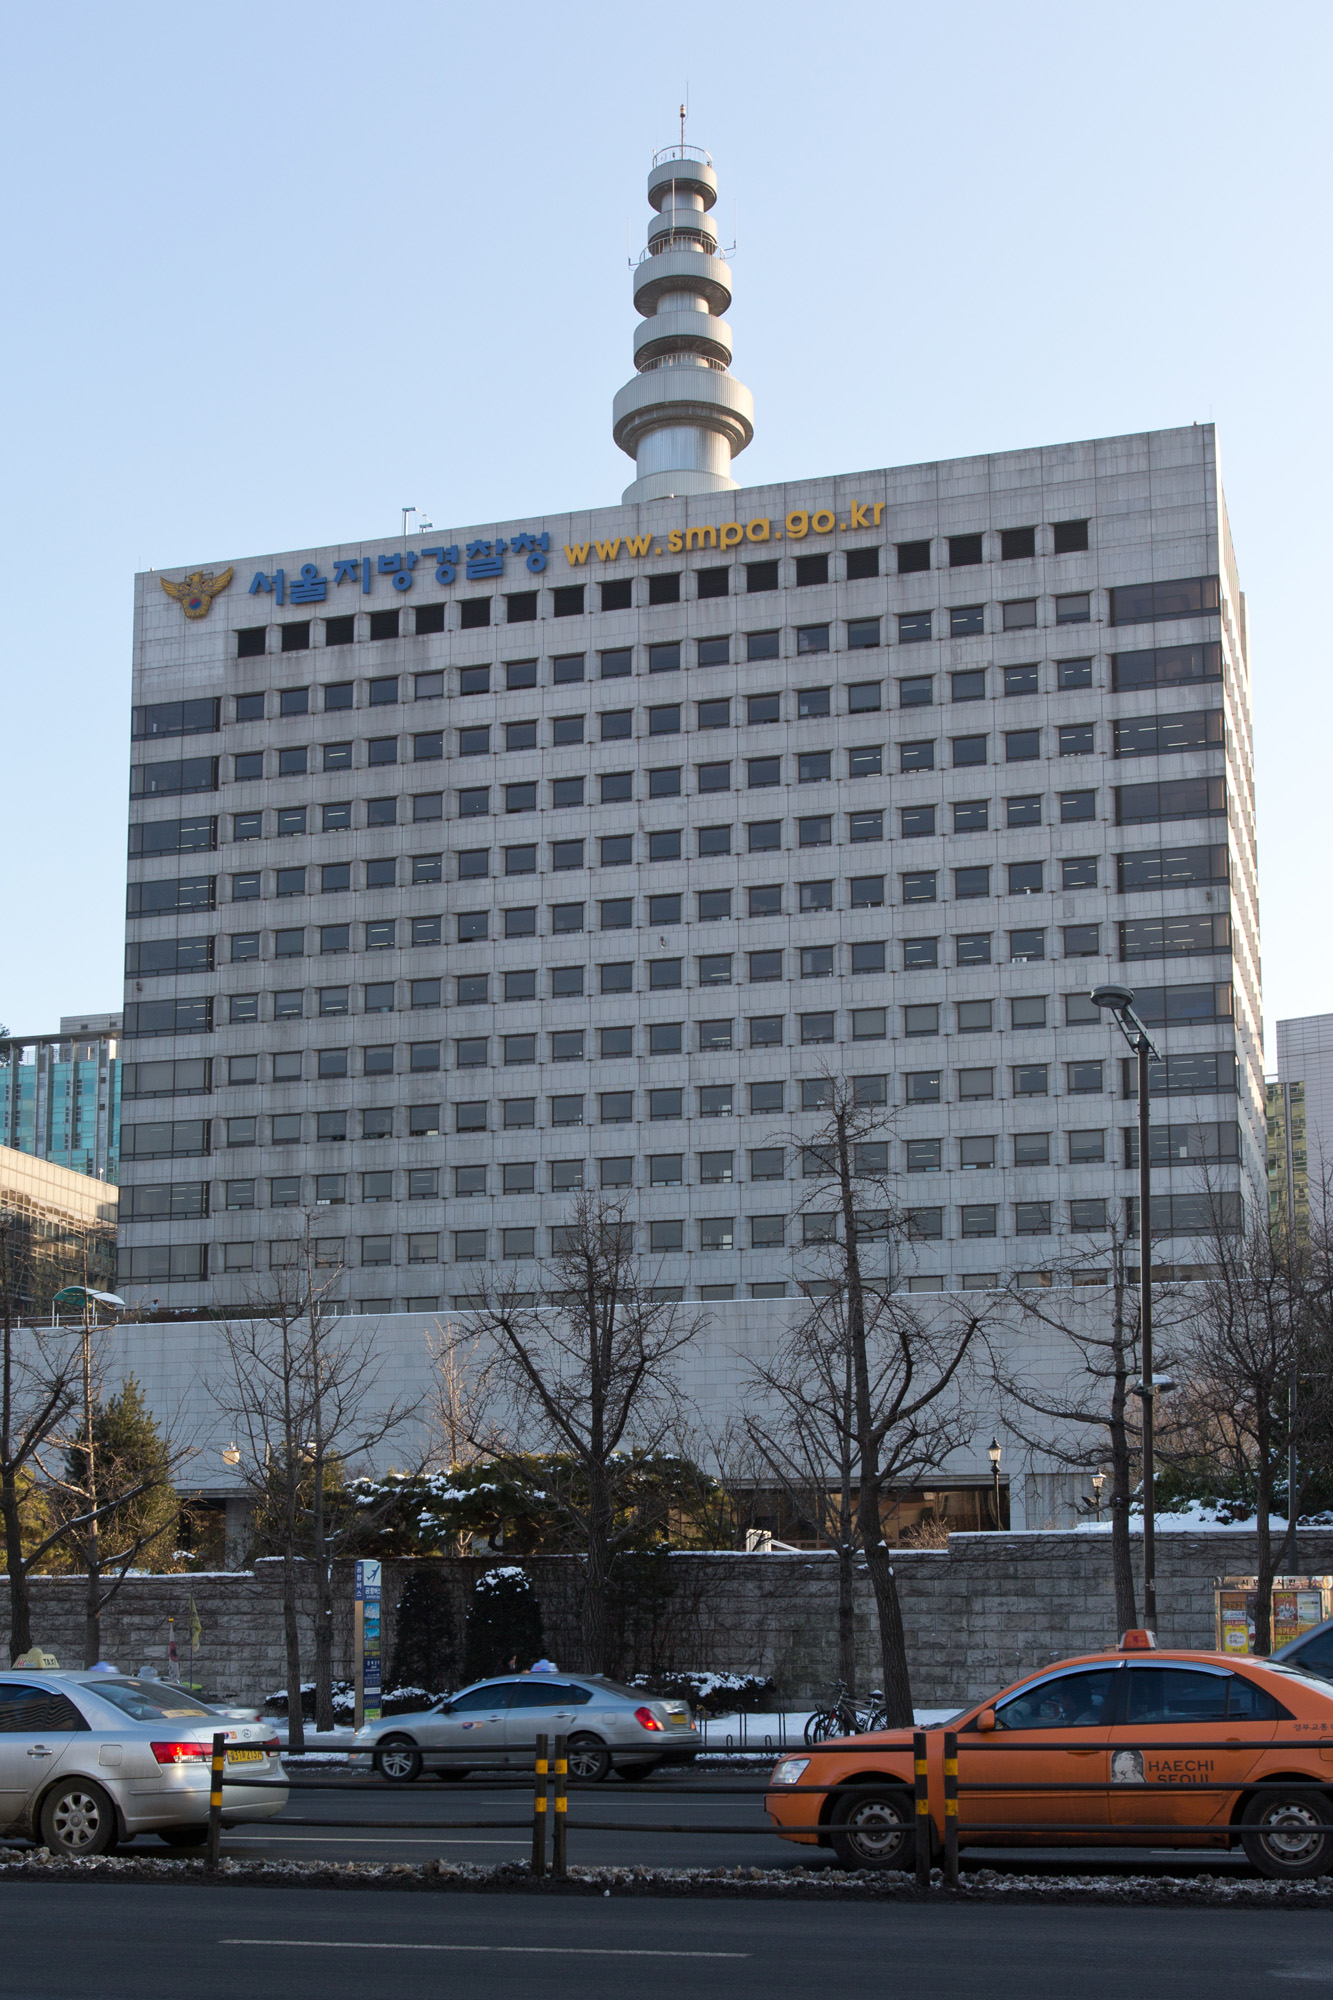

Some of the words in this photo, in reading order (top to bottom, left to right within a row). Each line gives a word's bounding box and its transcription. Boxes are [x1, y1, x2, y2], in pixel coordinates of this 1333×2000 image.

[563, 499, 885, 567] www.smpa.go.kr
[249, 532, 549, 606] 서울지방경찰청
[43, 1658, 57, 1666] TAXI
[1148, 1760, 1214, 1772] HAECHI
